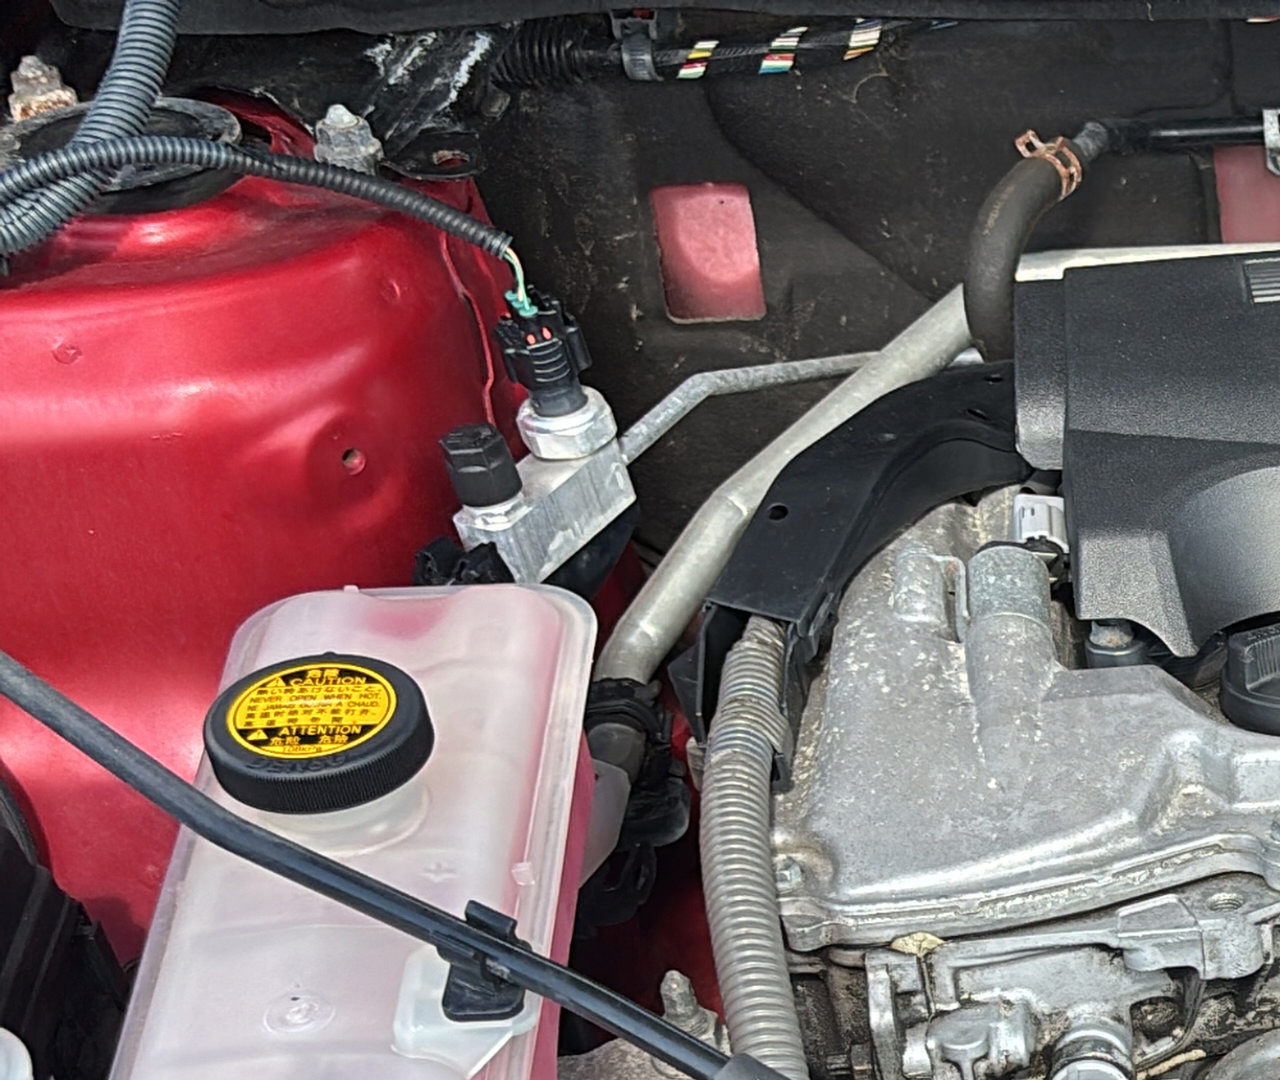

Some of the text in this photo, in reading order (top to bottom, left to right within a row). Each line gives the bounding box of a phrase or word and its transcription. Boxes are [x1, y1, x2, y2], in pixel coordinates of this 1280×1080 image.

[289, 677, 366, 686] CAUTION
[250, 695, 282, 703] NEVER
[278, 725, 362, 736] ATTENTION
